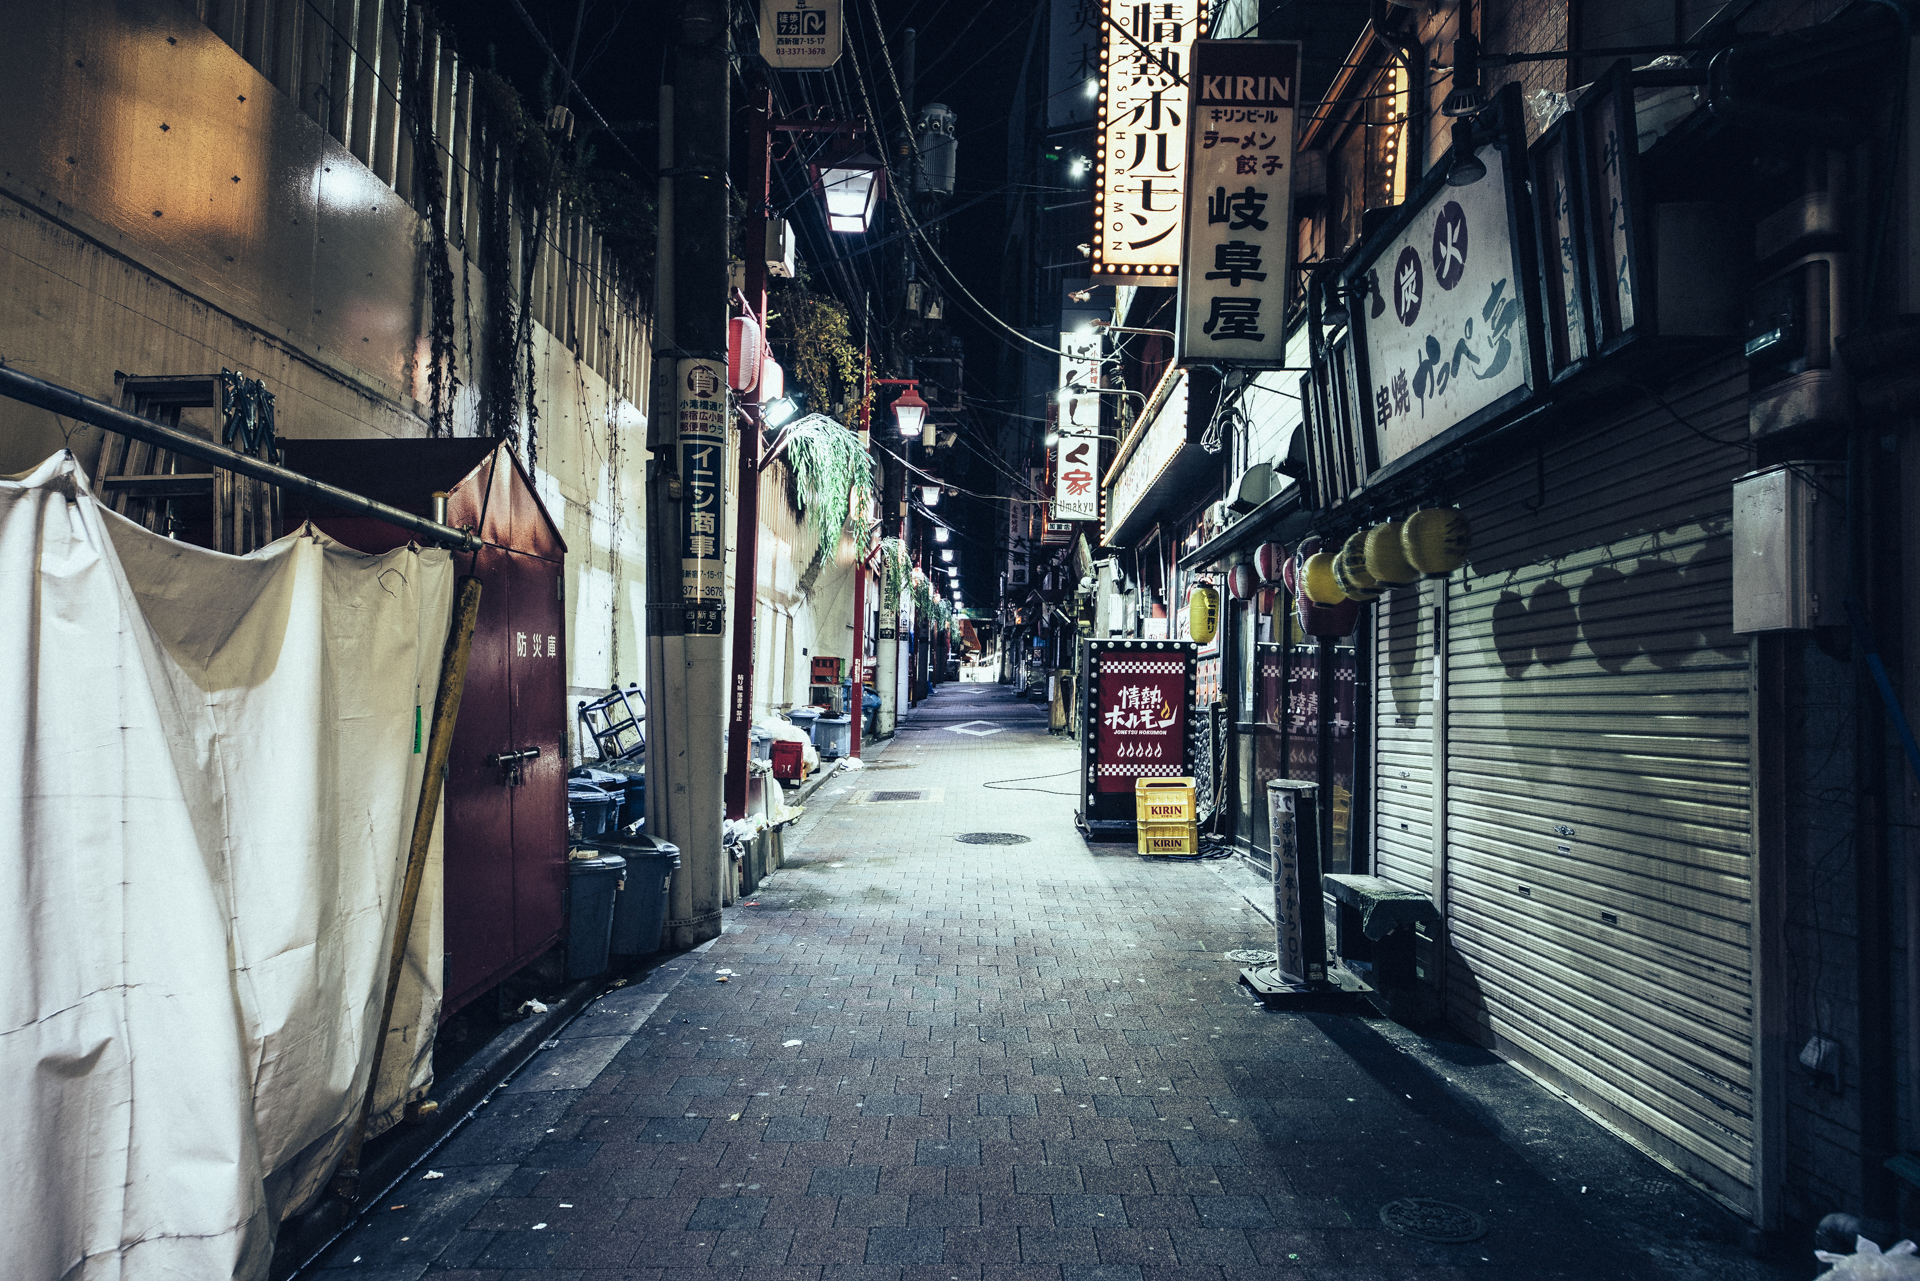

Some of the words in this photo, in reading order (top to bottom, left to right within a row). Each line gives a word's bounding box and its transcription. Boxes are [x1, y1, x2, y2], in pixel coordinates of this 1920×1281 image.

[778, 13, 799, 24] 徒歩
[780, 24, 799, 34] 7分
[775, 47, 826, 55] 03-3371-3678
[776, 37, 825, 45] 西新宿7-15-17
[1114, 2, 1131, 111] JONETSU
[1201, 74, 1290, 102] KIRIN
[1126, 2, 1185, 251] 情熱ホルモン
[1210, 108, 1279, 124] キリンビール
[1203, 130, 1277, 151] ラーメン
[1235, 154, 1284, 176] 餃子
[1111, 131, 1127, 252] HORUMON
[1204, 186, 1269, 342] 岐阜屋
[1399, 220, 1464, 318] 炭火
[688, 367, 717, 396] 質
[679, 399, 724, 413] 小滝橋通り
[679, 410, 724, 425] 新宿広小路
[679, 421, 724, 435] 郵便局ウラ
[688, 446, 716, 559] イニシ商事
[1059, 499, 1094, 513] Umakyu
[685, 609, 717, 620] 西新宿
[691, 620, 713, 631] 1-2
[516, 631, 557, 659] 防災庫
[1117, 684, 1164, 710] 情熱
[1104, 704, 1179, 731] ホルモン
[1150, 805, 1182, 815] KIRIN
[1153, 839, 1182, 848] KIRIN
[1281, 819, 1301, 974] 串焼一本からOK
